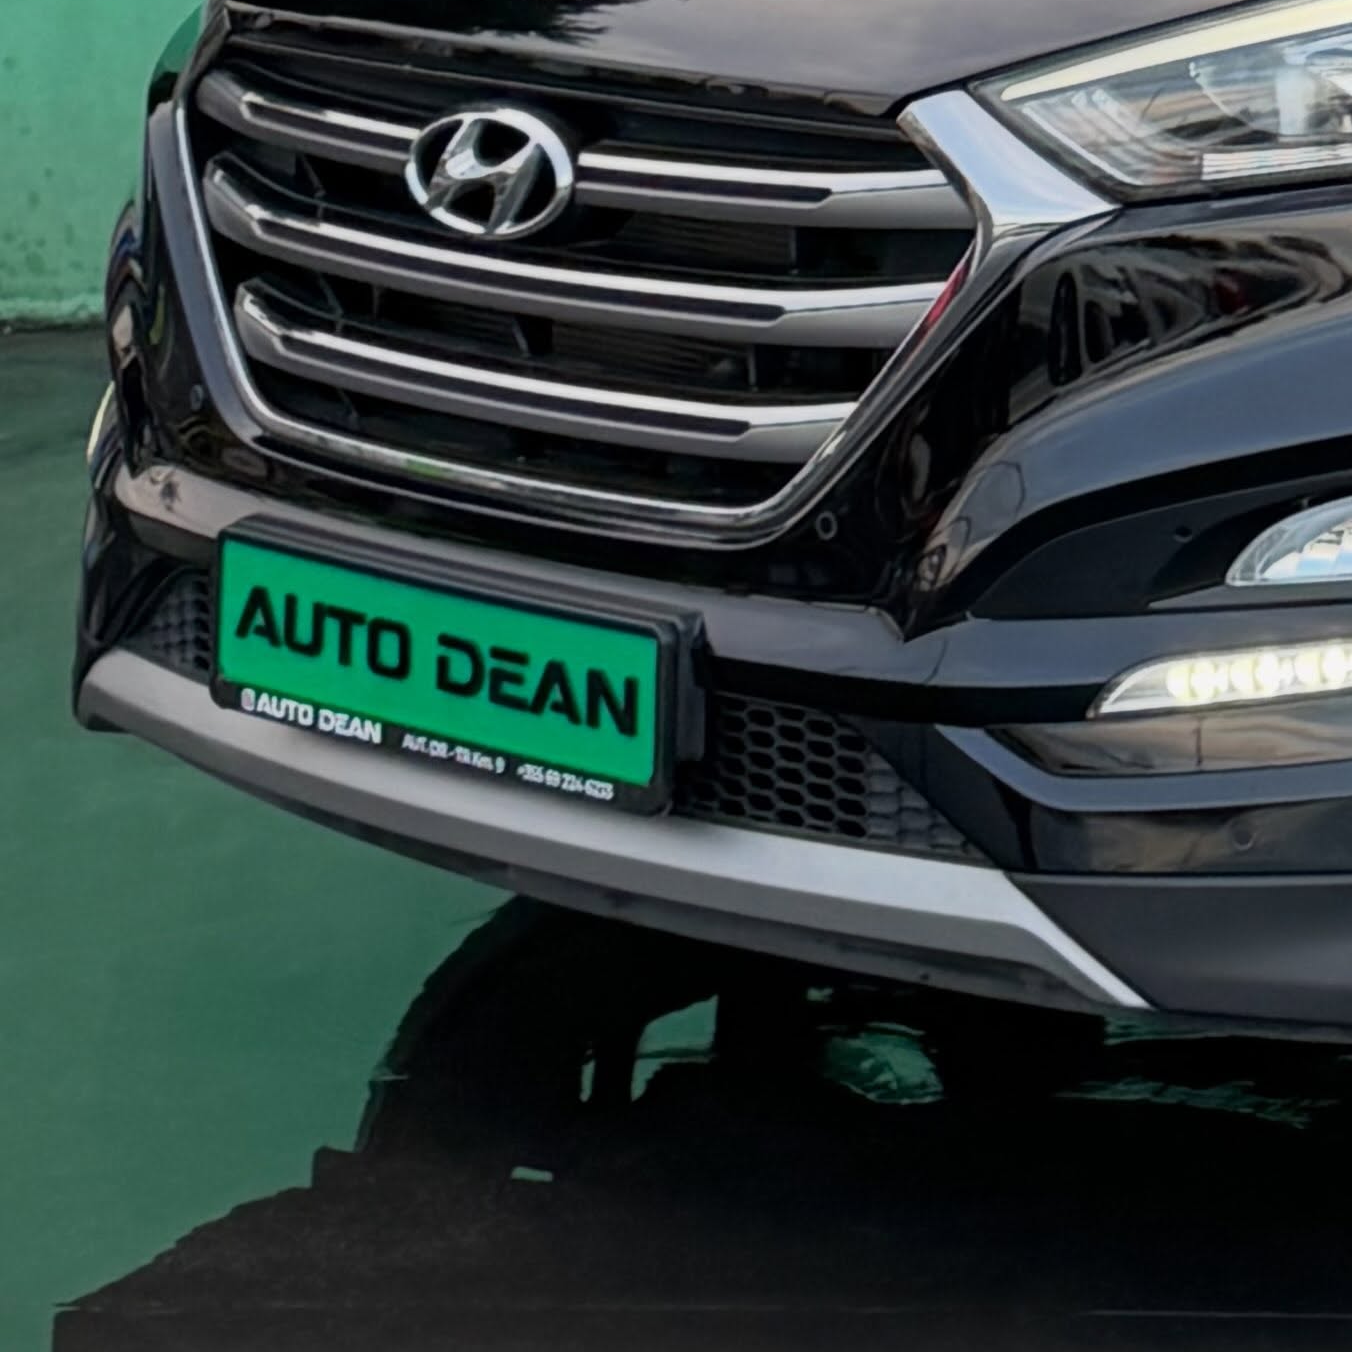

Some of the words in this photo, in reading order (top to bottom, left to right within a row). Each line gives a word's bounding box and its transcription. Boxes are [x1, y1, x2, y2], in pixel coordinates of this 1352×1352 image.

[235, 585, 412, 681] AUTO
[436, 632, 639, 739] DEAN
[256, 692, 314, 726] AUTO
[318, 709, 382, 744] DEAN
